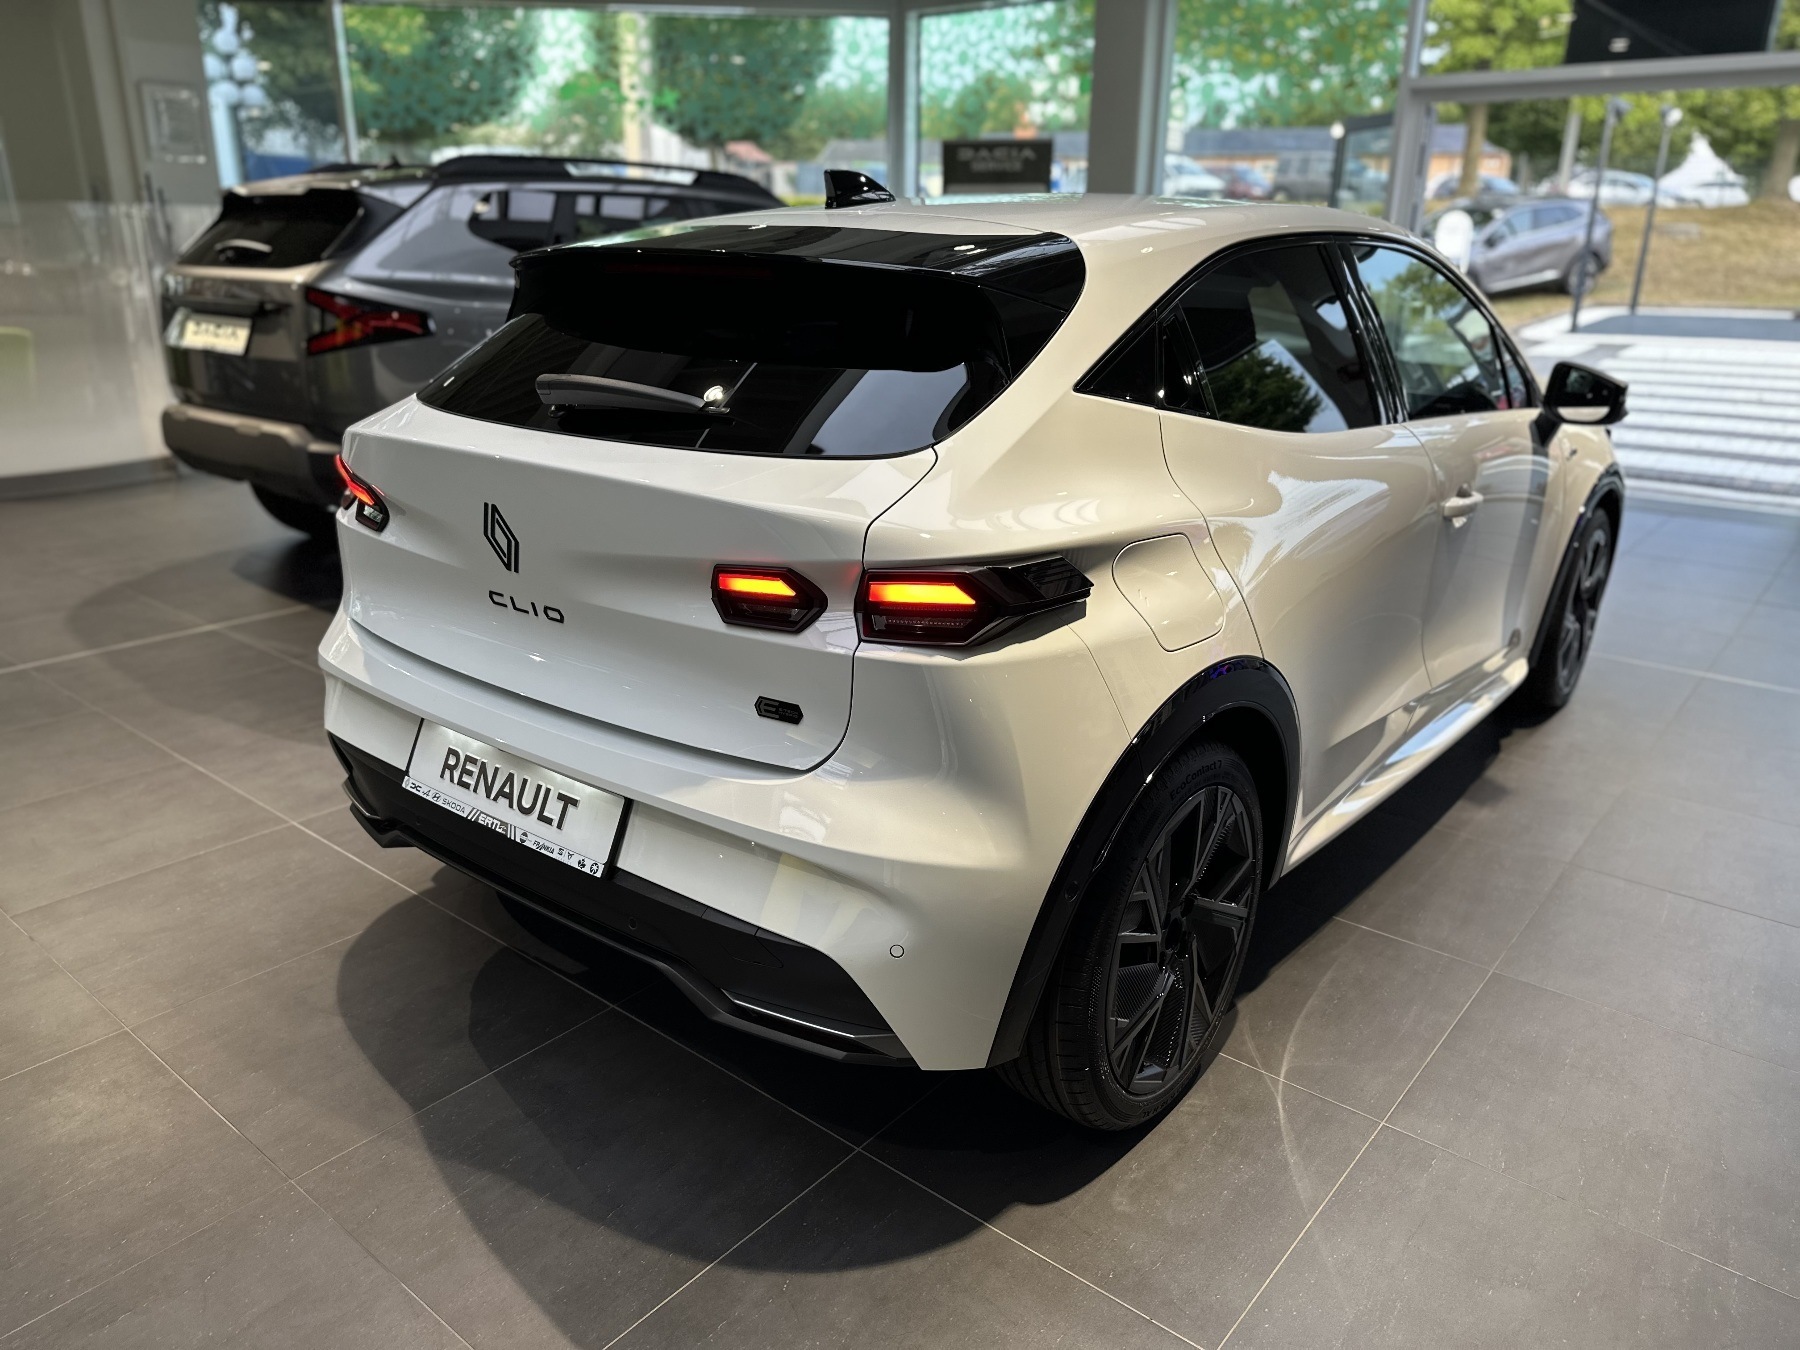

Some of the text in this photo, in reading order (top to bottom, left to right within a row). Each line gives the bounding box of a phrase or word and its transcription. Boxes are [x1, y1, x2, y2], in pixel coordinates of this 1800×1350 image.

[488, 589, 565, 624] CLIO
[439, 746, 580, 831] RENAULT
[1169, 761, 1217, 801] EcoContact
